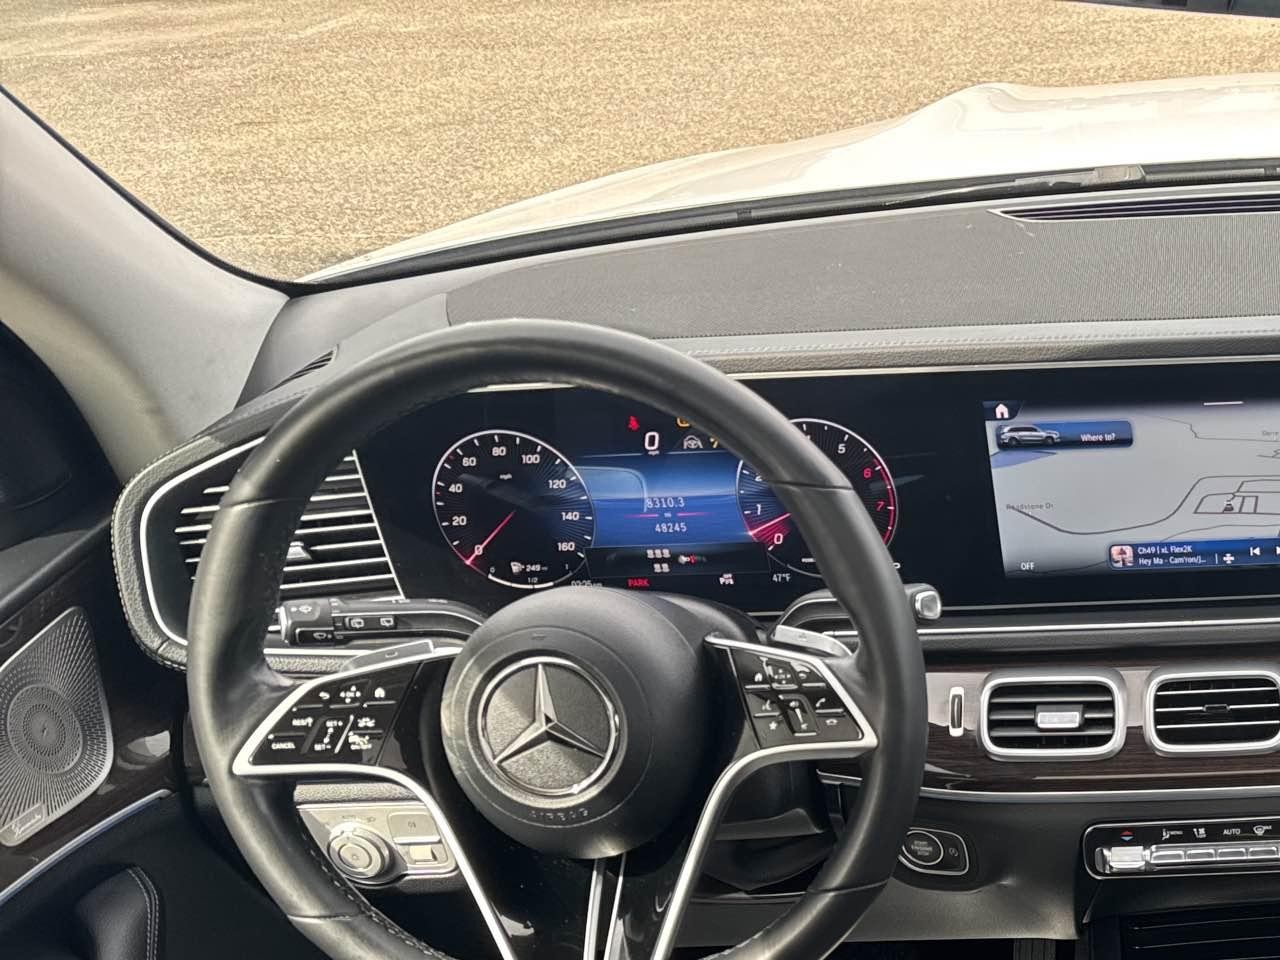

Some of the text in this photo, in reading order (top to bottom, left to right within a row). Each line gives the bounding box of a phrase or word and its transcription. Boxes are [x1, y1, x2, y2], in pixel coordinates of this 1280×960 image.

[644, 431, 660, 450] 0
[1080, 432, 1116, 442] Where to?
[492, 446, 506, 456] 80
[838, 444, 846, 454] 5
[462, 458, 476, 467] 60
[522, 454, 540, 464] 100
[863, 468, 872, 478] 6
[448, 484, 463, 493] 40
[548, 480, 566, 489] 120
[756, 504, 762, 515] 1
[876, 502, 884, 512] 7
[452, 516, 467, 526] 20
[561, 512, 580, 521] 140
[654, 522, 687, 533] 48245
[774, 533, 784, 545] 0
[557, 542, 576, 551] 160
[1138, 546, 1156, 554] Ch49
[1170, 545, 1192, 553] Flex2K
[1020, 562, 1035, 570] OFF
[1138, 557, 1152, 566] Hey
[1153, 556, 1164, 564] Ma
[526, 564, 541, 572] 249
[627, 578, 650, 588] PARK
[271, 742, 296, 750] CANCEL
[1222, 828, 1240, 836] AUTO
